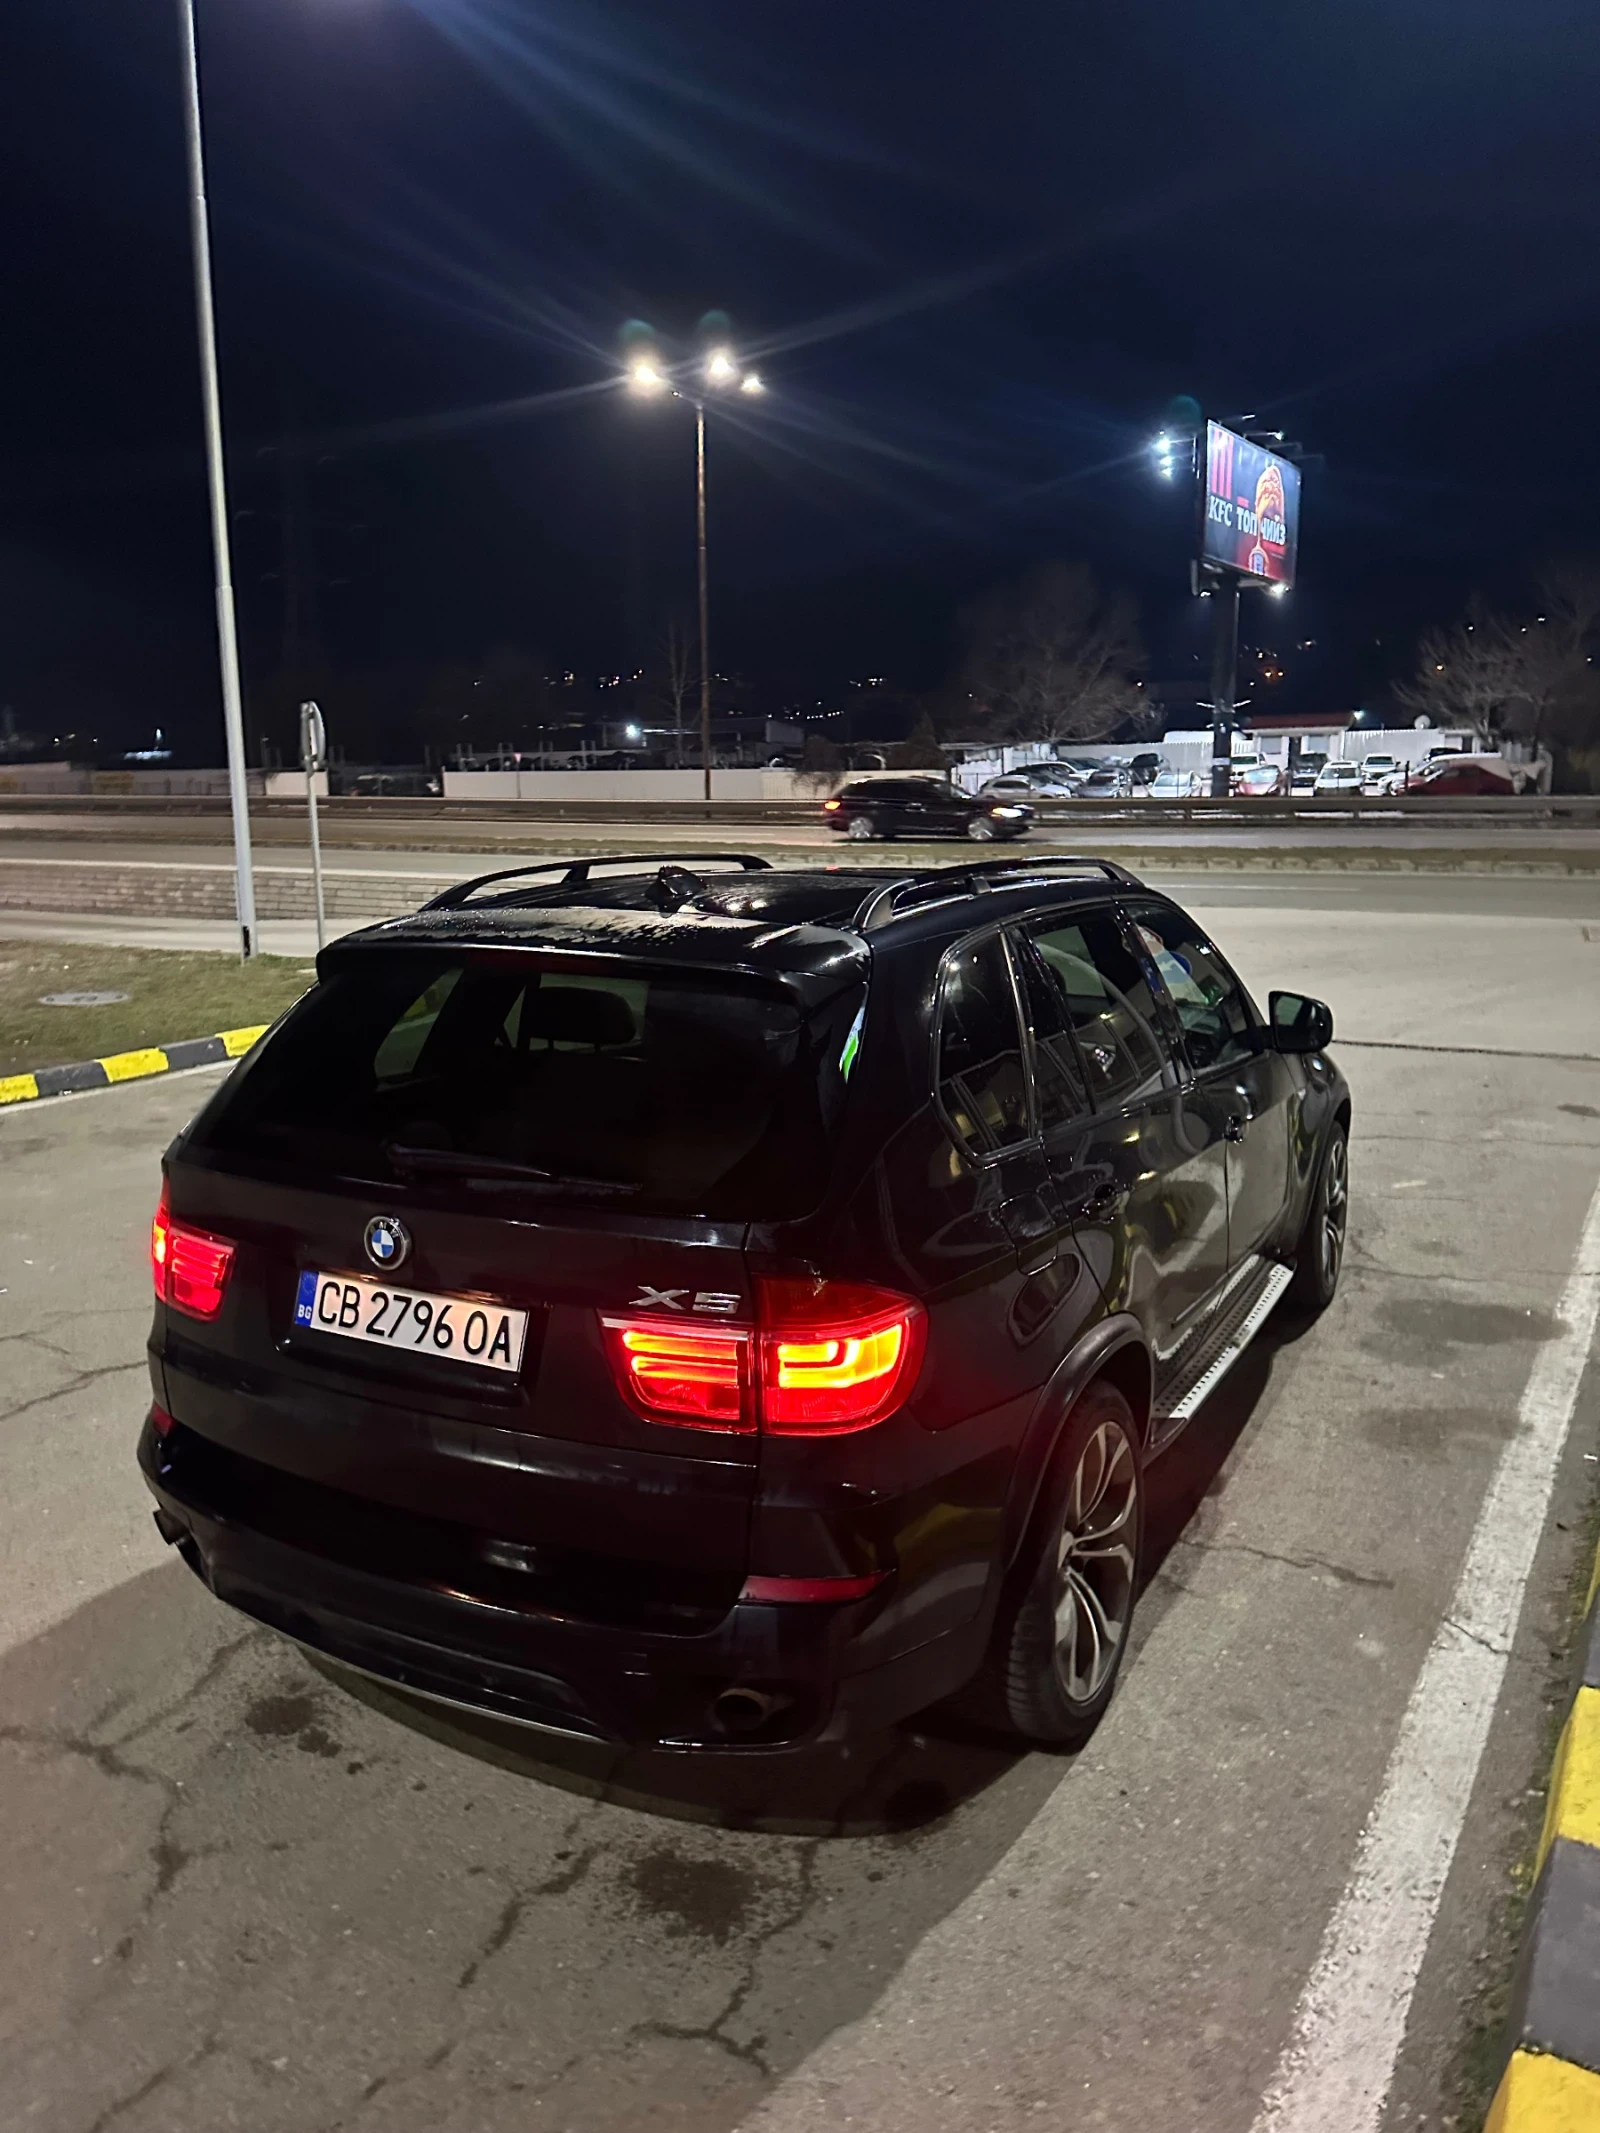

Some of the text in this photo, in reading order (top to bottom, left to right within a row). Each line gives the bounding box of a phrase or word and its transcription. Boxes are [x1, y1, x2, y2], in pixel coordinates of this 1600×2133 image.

[1208, 496, 1286, 545] KFC ТОП ЧИЙЗ
[298, 1304, 312, 1320] BG
[628, 1286, 741, 1314] X5
[318, 1281, 510, 1363] CB 2796 OA
